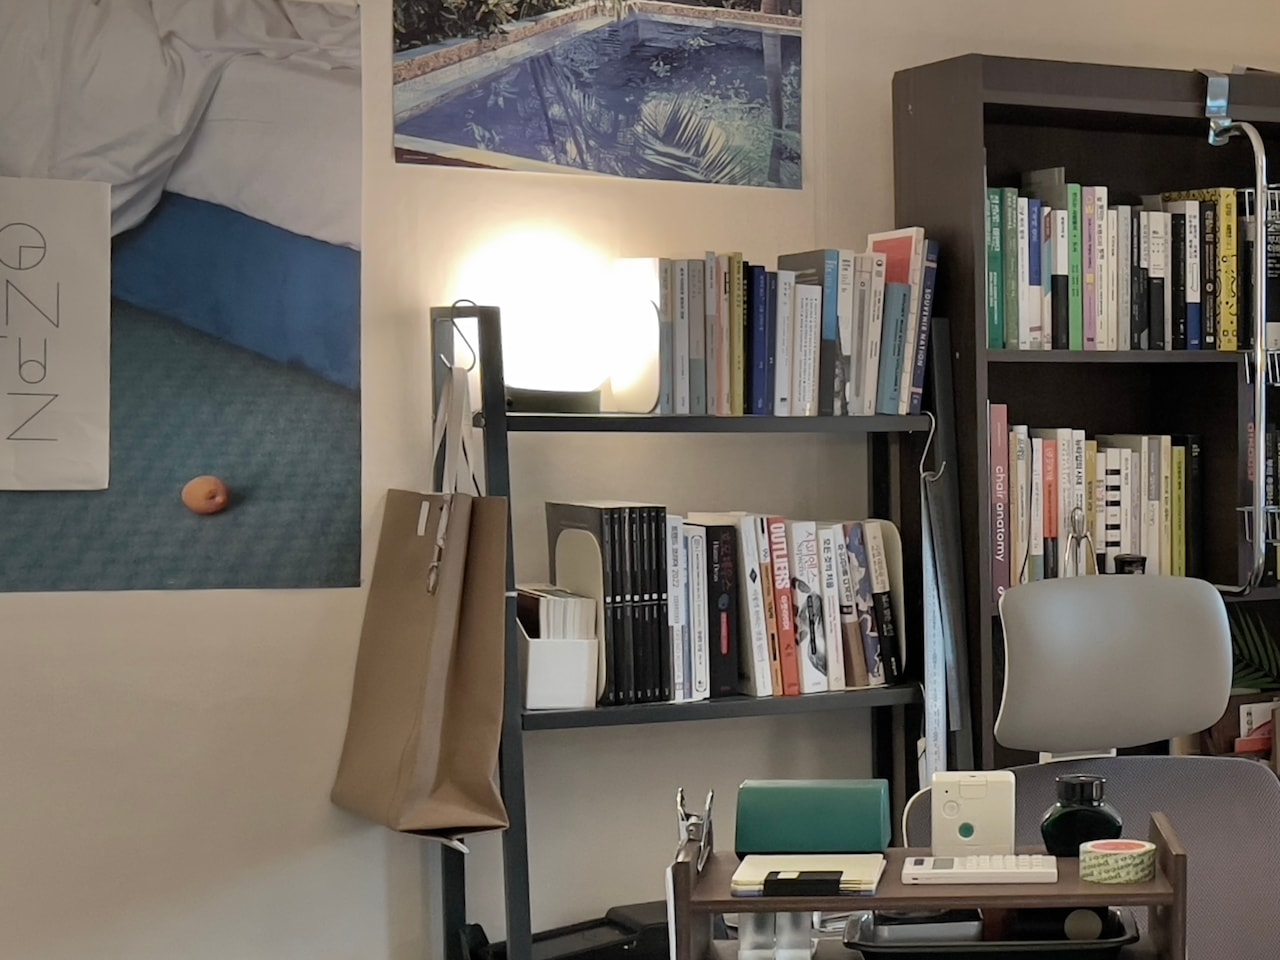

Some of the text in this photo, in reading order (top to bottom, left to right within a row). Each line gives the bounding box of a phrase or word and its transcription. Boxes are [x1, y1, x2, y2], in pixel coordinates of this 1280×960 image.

[916, 288, 932, 367] SOUVENIR NATION
[1075, 470, 1083, 486] 시대
[995, 465, 1006, 562] chair anatomy
[712, 541, 720, 562] Homo
[770, 522, 790, 590] OUTLIERS
[803, 530, 819, 583] 사피엔스
[823, 538, 835, 589] 모든 것의 처음
[672, 569, 680, 588] 2022
